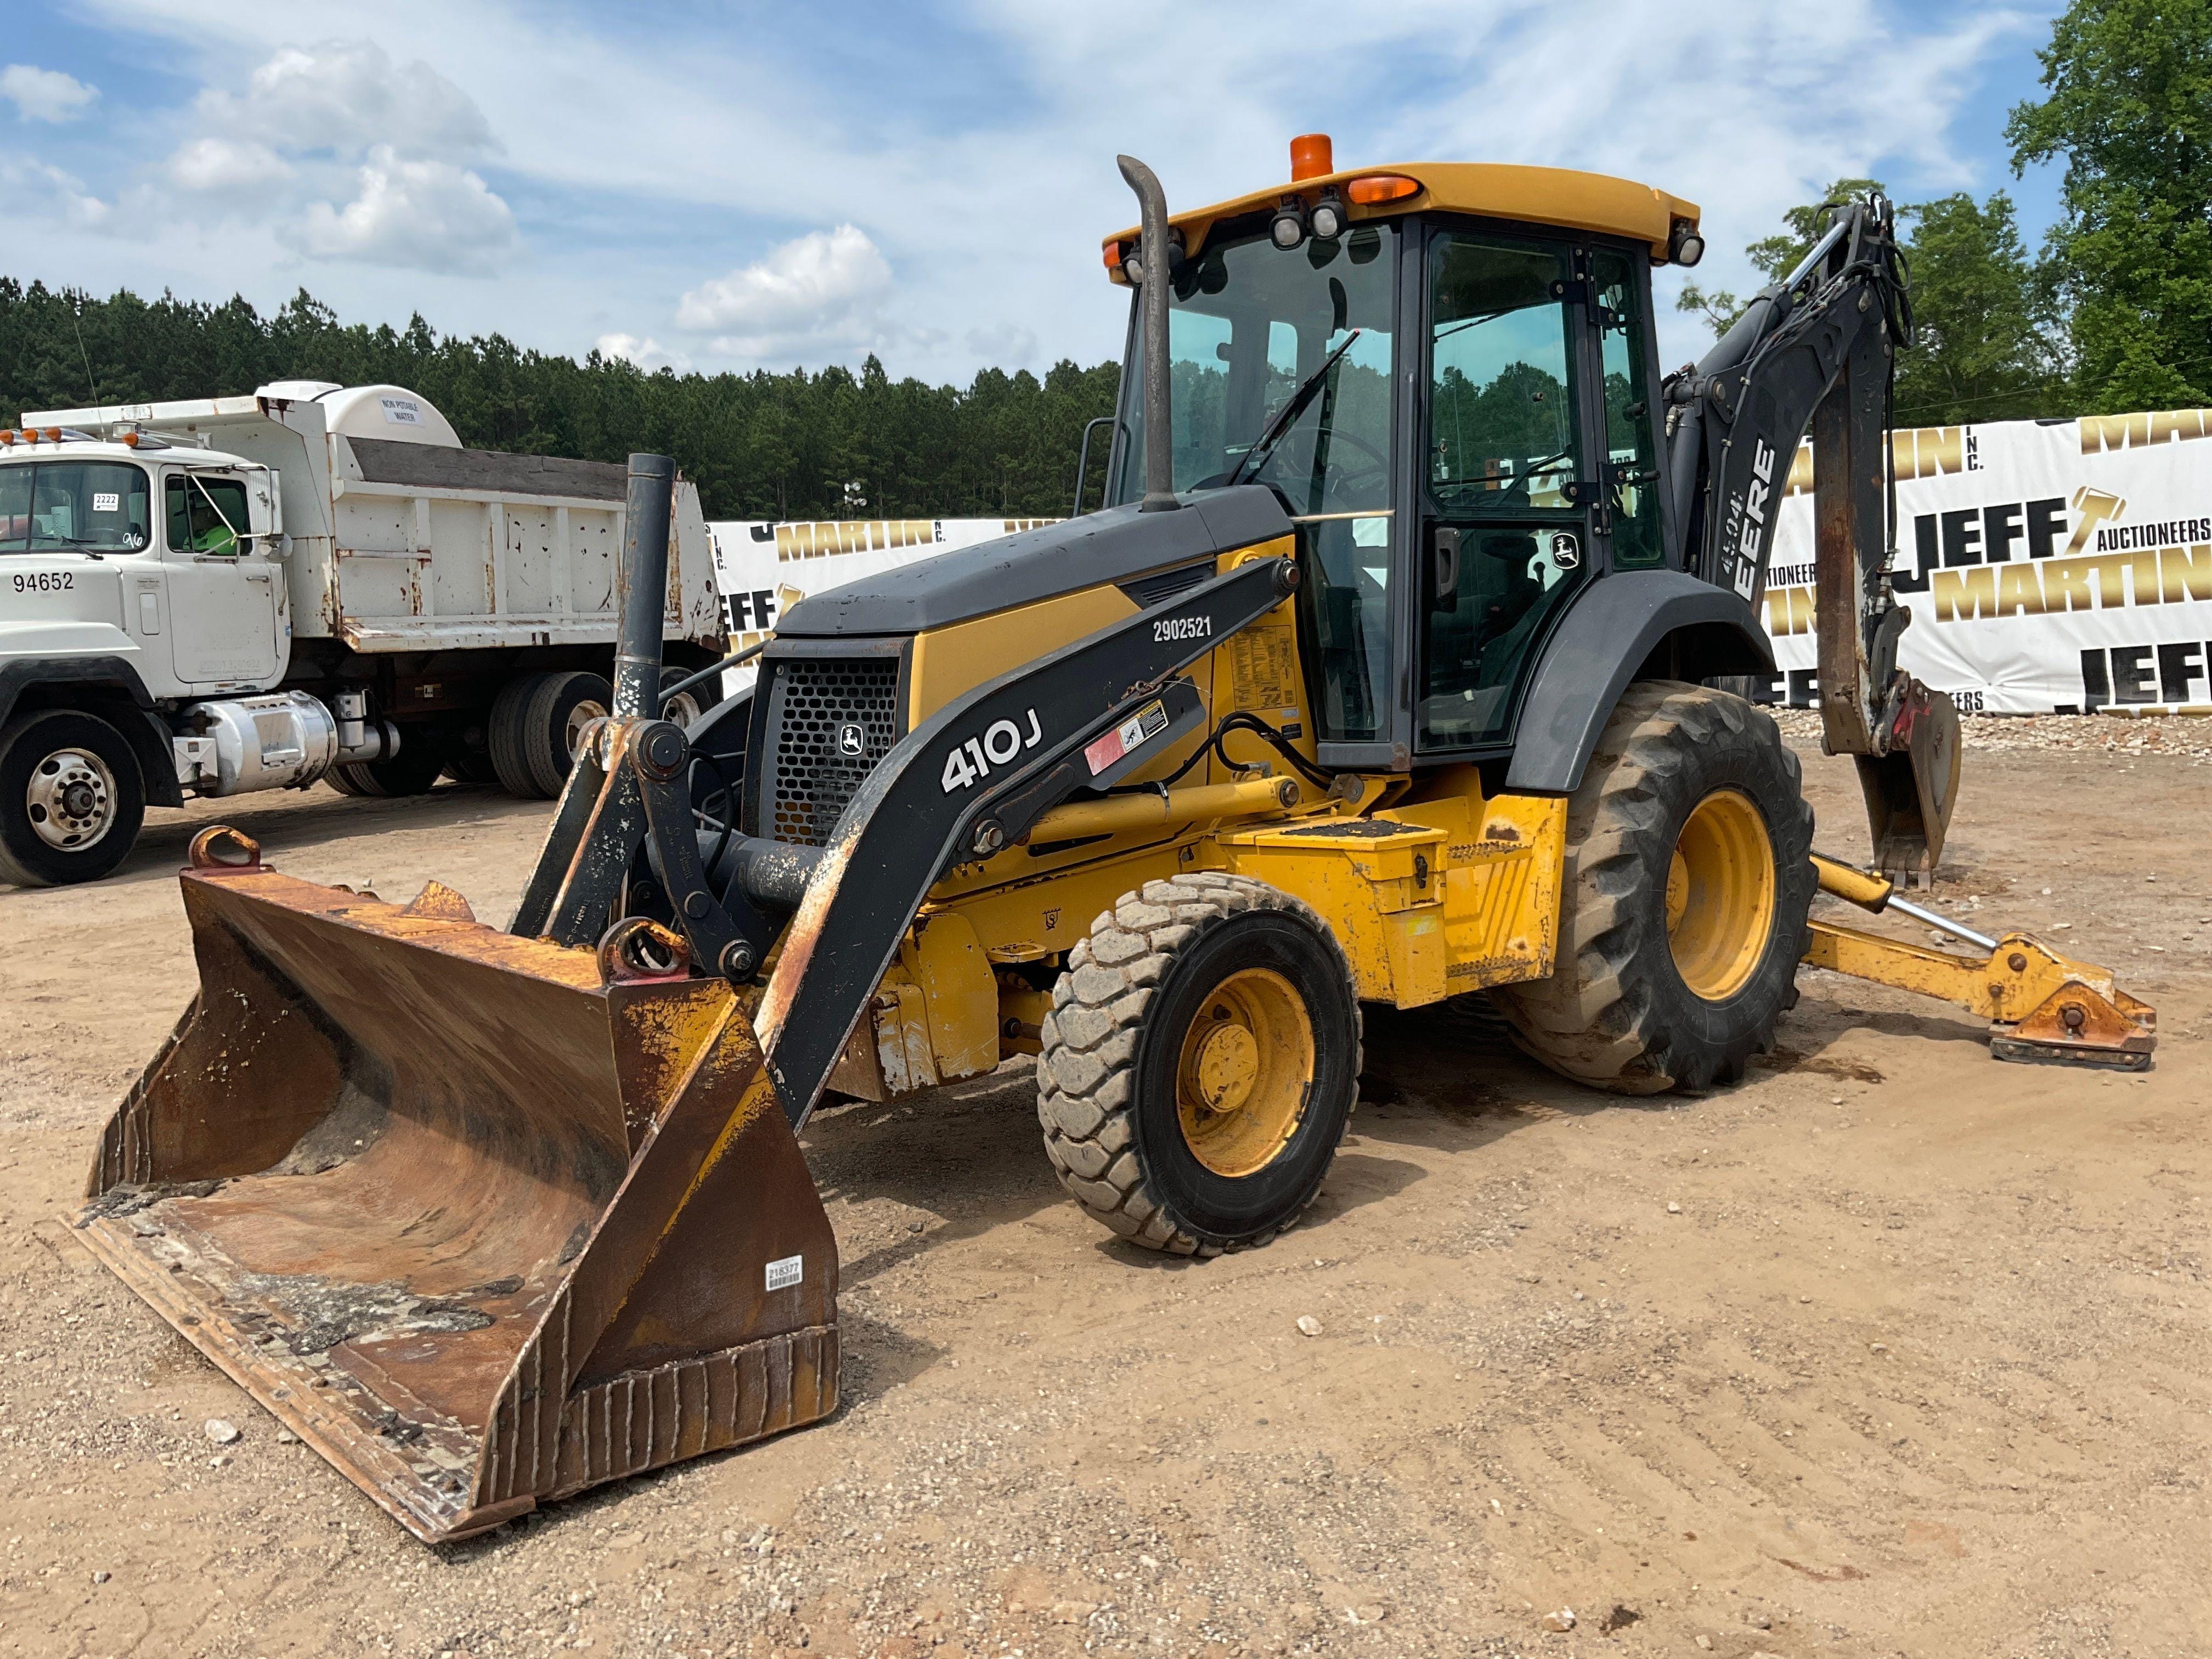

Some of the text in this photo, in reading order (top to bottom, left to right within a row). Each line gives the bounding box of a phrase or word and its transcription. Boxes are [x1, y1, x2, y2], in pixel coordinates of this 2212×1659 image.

[382, 399, 419, 411] NON POTABLE
[394, 411, 416, 422] WATER
[1966, 426, 1984, 471] INC.
[96, 495, 116, 504] 2222
[1734, 438, 1776, 602] EERE
[2097, 518, 2211, 552] AUCTIONEERS
[122, 532, 143, 549] 96
[714, 535, 727, 570] INC.
[776, 522, 933, 563] MARTIN
[1891, 496, 2069, 594] JEFF
[13, 572, 74, 592] 94652
[1768, 563, 1816, 587] TIONEER
[1933, 545, 2212, 622] MARTIN
[1153, 616, 1212, 642] 2902521
[2053, 640, 2212, 715] JEF
[940, 708, 1043, 794] 410J
